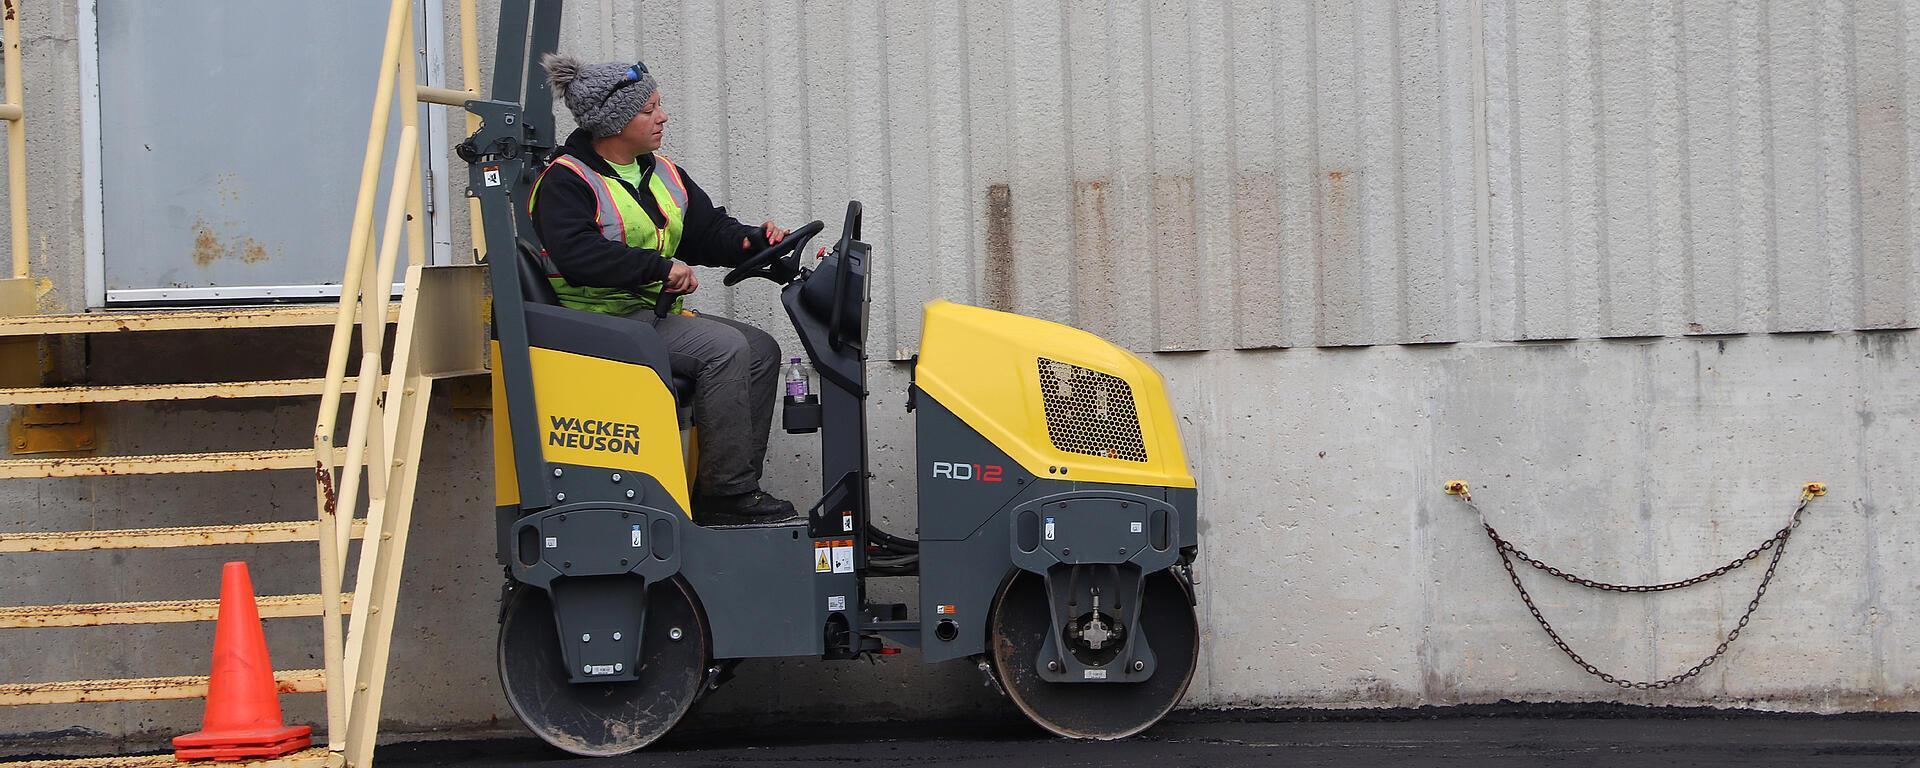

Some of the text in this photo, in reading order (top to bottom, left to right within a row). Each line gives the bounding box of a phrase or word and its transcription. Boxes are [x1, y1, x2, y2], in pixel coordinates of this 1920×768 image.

[550, 415, 640, 439] WACKER
[549, 432, 640, 455] NEUSON
[932, 461, 1003, 482] RD12
